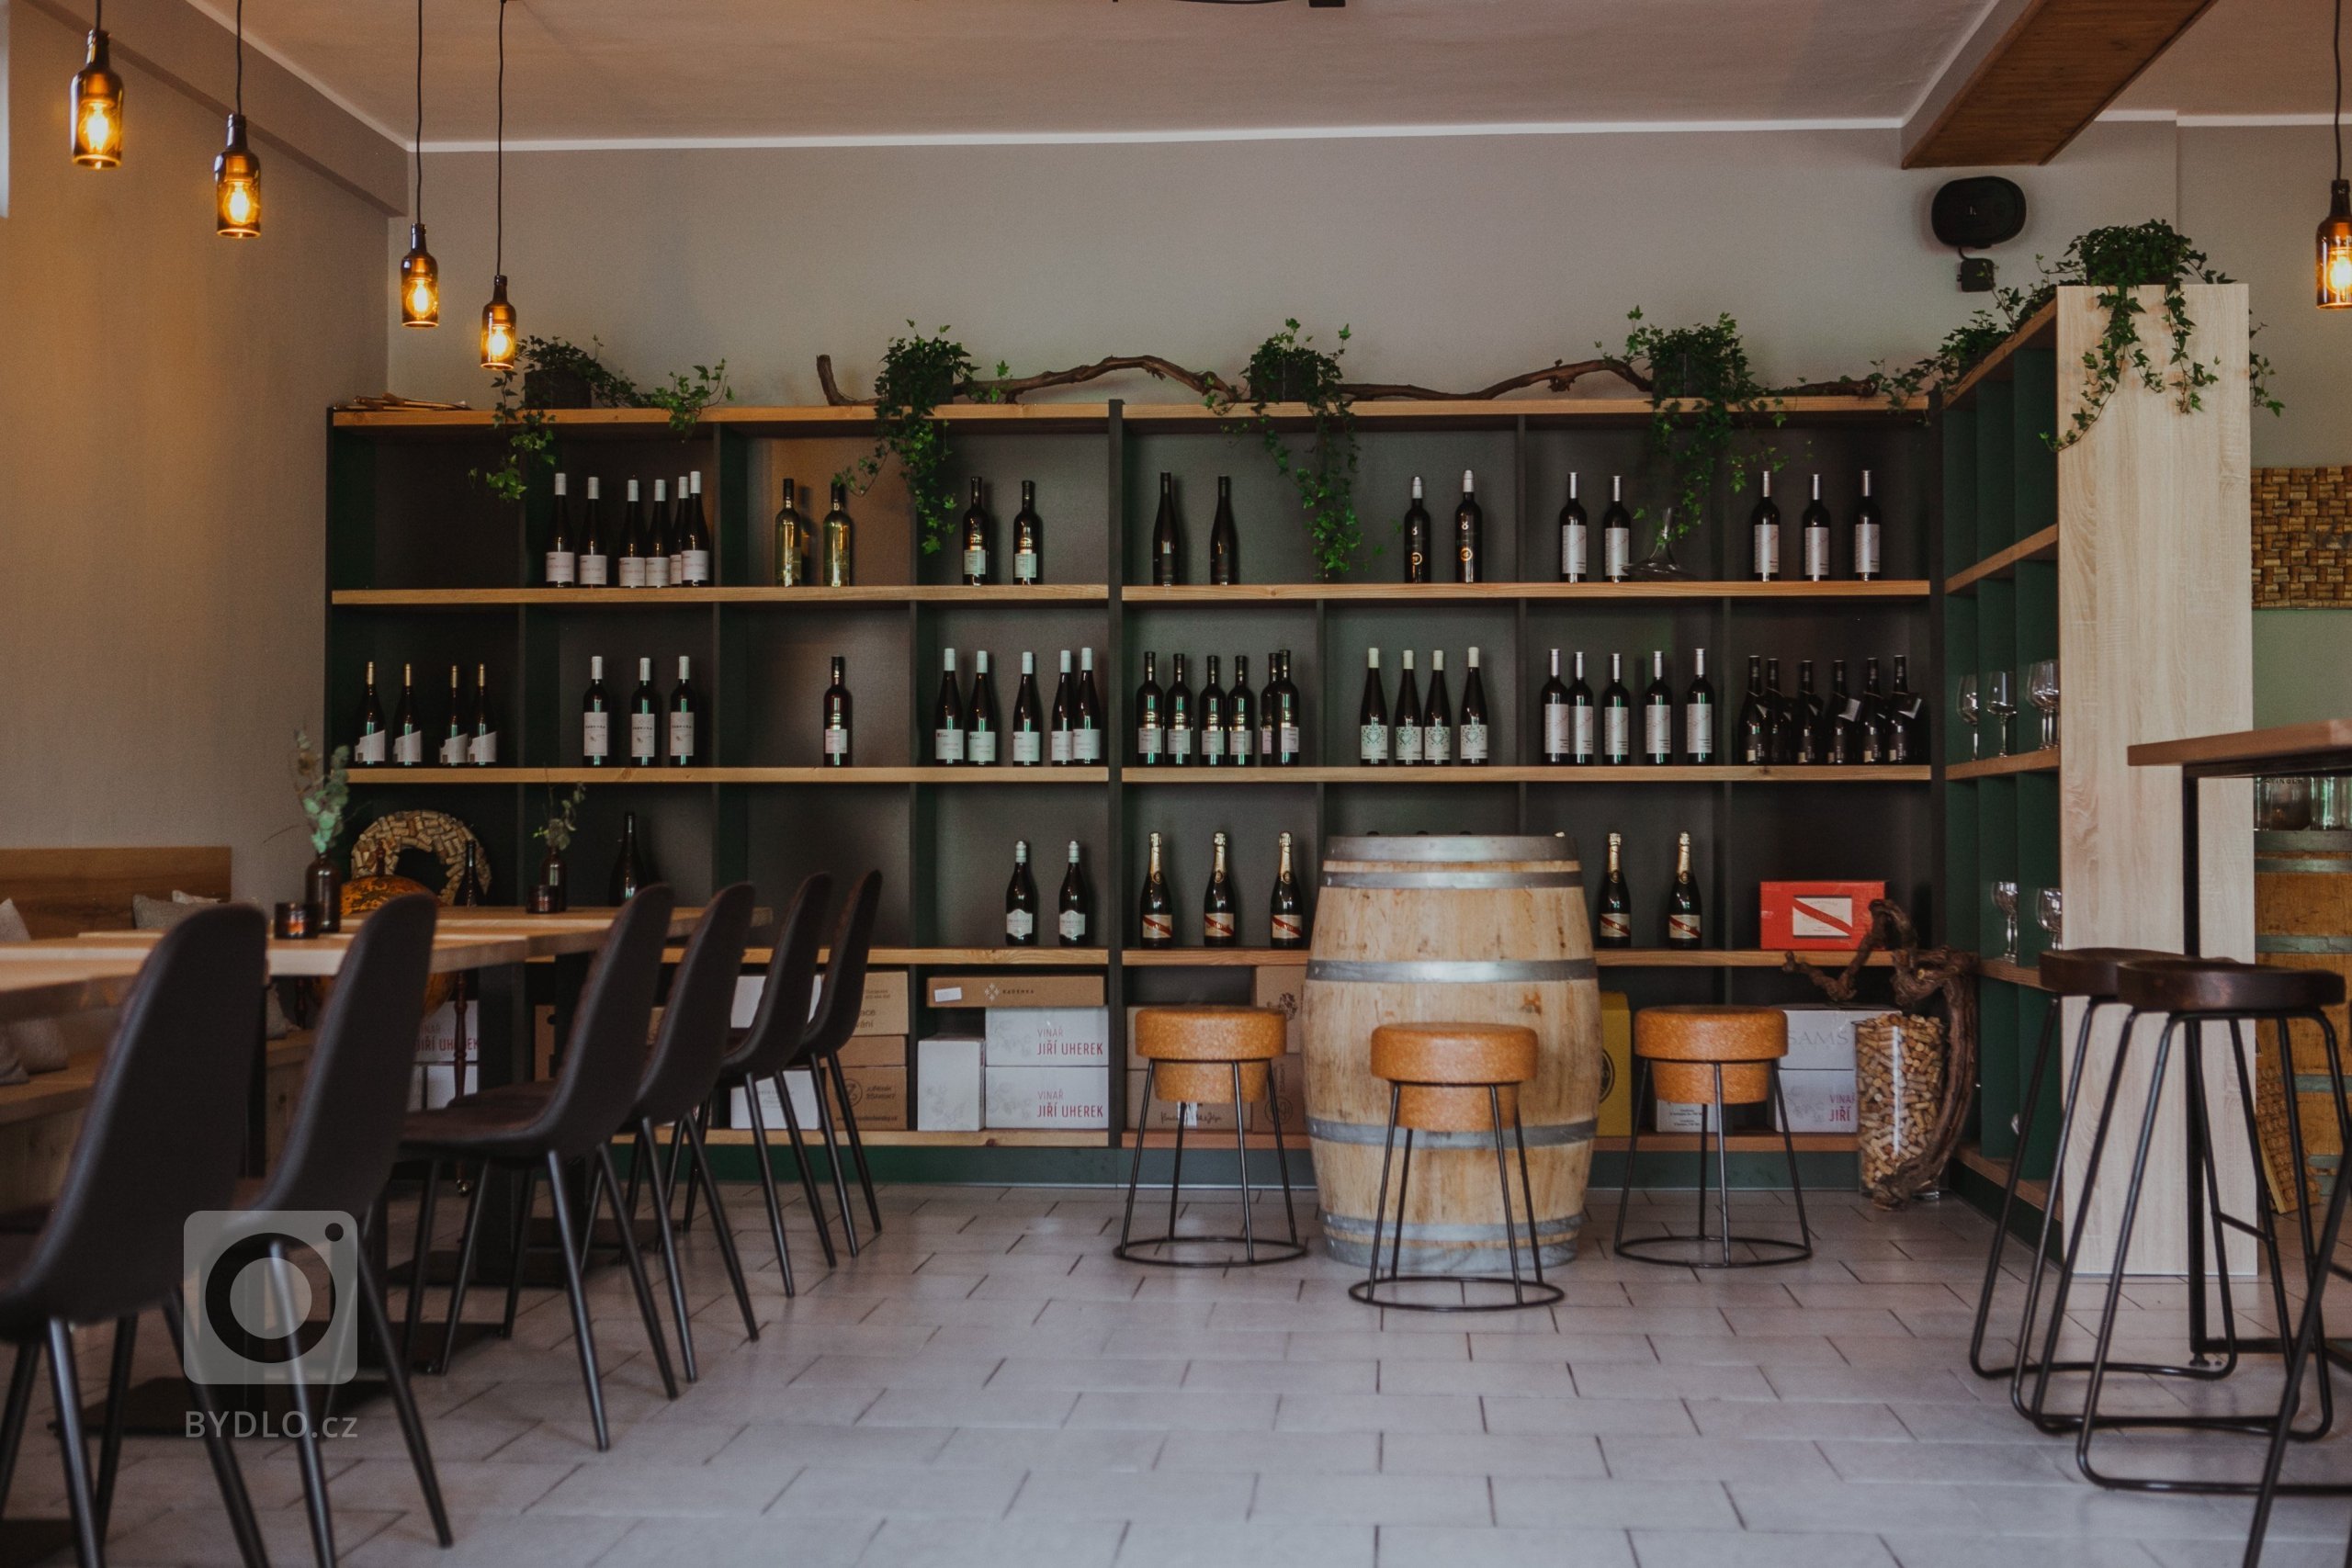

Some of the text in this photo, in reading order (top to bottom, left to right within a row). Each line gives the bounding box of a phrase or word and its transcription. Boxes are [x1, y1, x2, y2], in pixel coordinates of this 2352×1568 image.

[1036, 1026, 1064, 1037] VINAŘ
[439, 1038, 479, 1052] UHEK
[1036, 1039, 1103, 1055] JIŘÍ UHEREK
[1036, 1088, 1064, 1100] VINAŘ
[1036, 1101, 1103, 1118] JIŘÍ UHEREK
[1828, 1105, 1850, 1122] JIŘÍ
